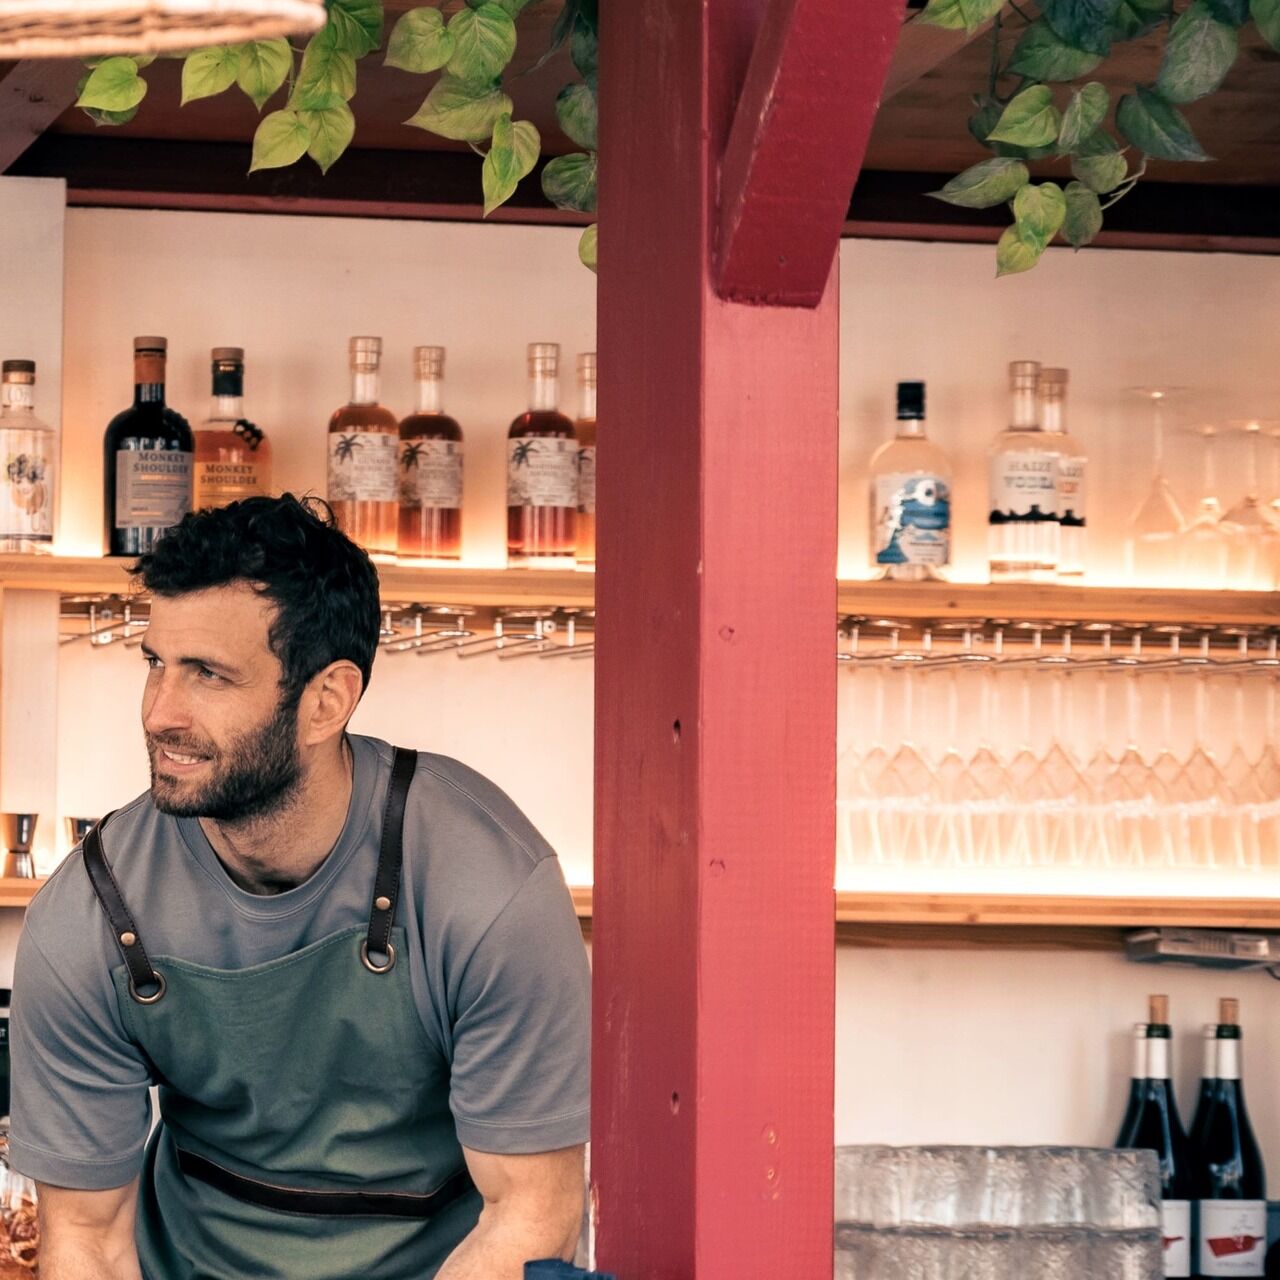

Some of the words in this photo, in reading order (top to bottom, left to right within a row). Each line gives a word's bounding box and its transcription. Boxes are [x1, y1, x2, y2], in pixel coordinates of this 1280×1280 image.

[138, 452, 185, 463] MONKEY
[133, 463, 188, 474] SHOULDER
[205, 464, 253, 474] MONKEY
[200, 475, 257, 485] SHOULDER
